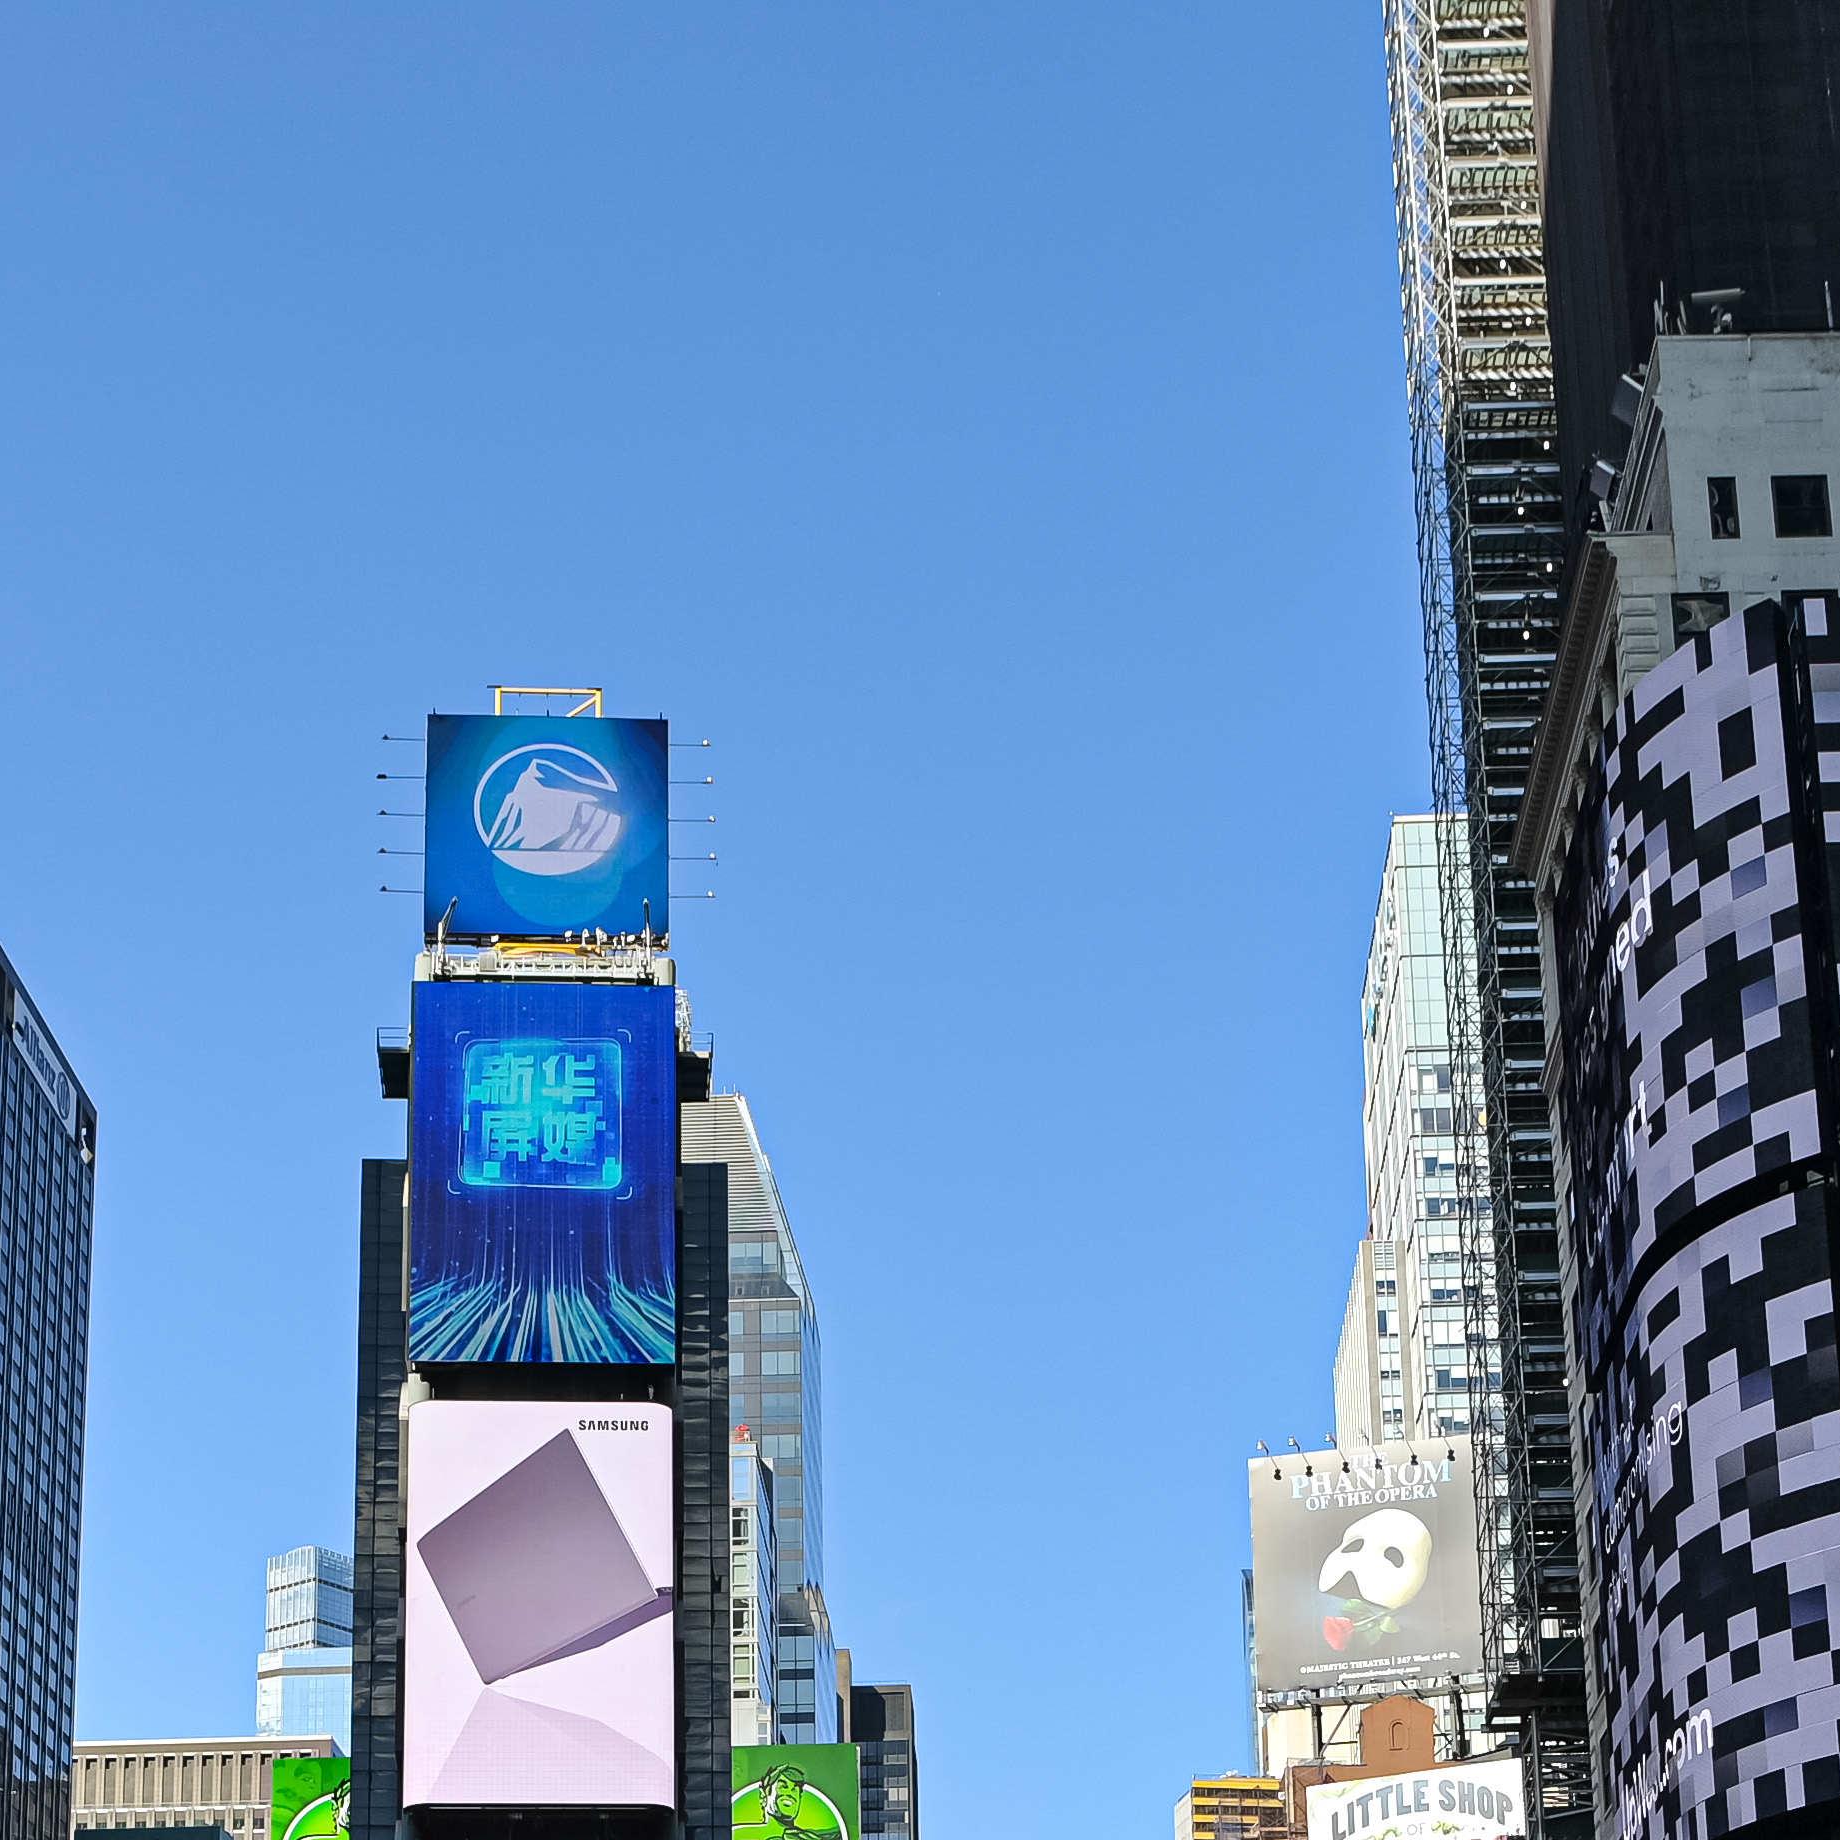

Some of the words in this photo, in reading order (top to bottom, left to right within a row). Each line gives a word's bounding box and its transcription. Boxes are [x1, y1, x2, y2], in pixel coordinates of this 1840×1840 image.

[578, 1419, 649, 1431] SAMSUNG
[1290, 1458, 1456, 1499] PHANTOM
[1305, 1494, 1332, 1511] OF
[1333, 1490, 1374, 1508] THE
[1375, 1484, 1438, 1504] OPERA
[1439, 1780, 1513, 1825] SHOP
